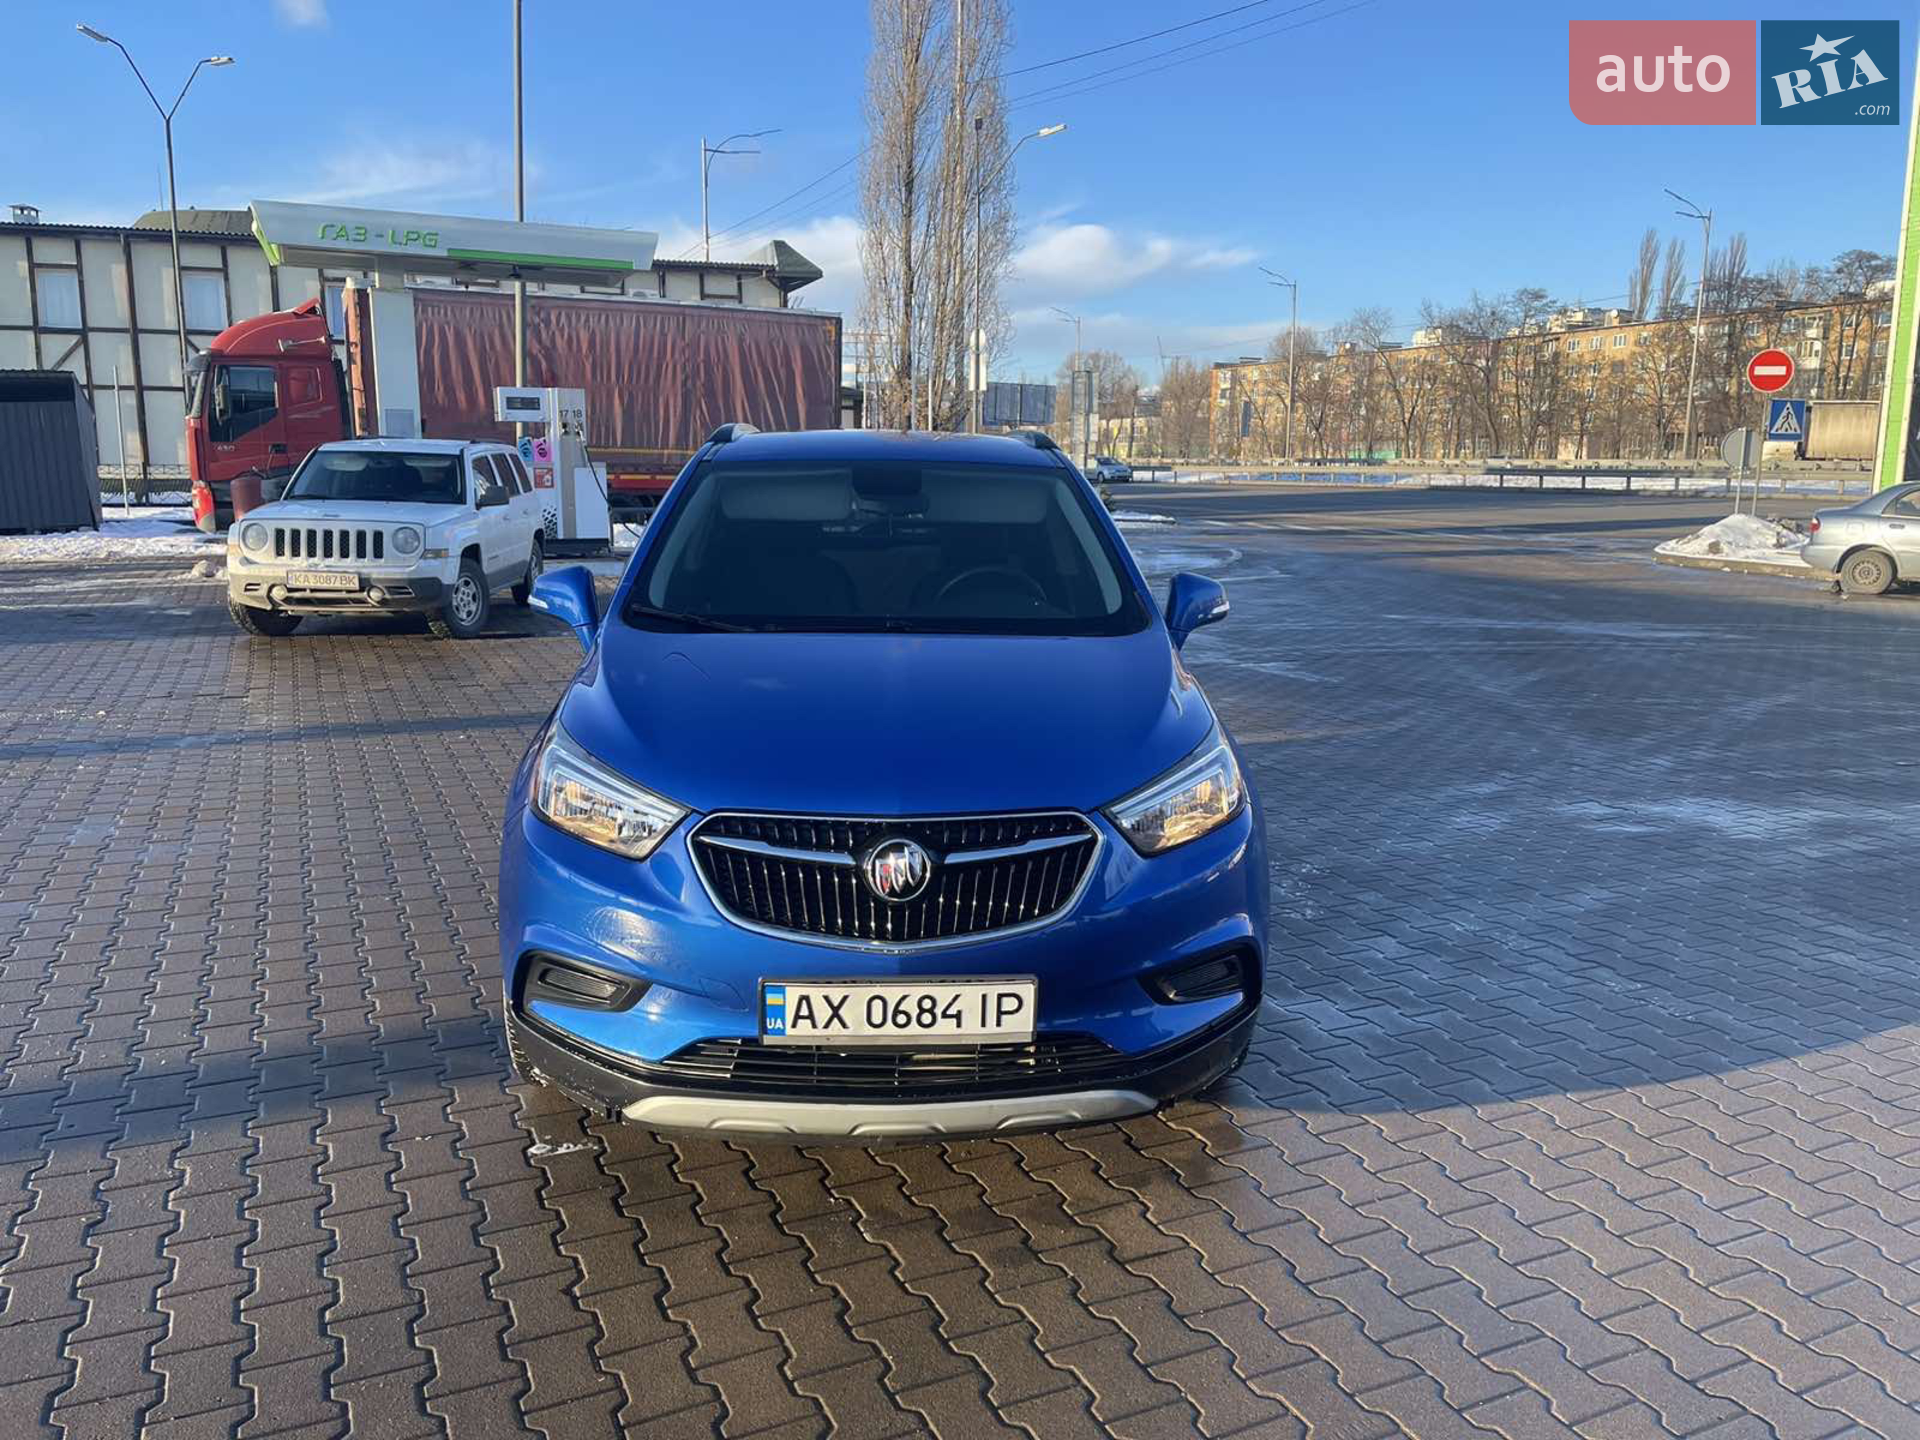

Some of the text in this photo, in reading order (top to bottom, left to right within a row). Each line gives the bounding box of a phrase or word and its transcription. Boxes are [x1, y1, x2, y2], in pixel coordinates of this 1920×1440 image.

[559, 409, 583, 419] 17 18
[294, 573, 357, 586] KA 3087 BK
[790, 992, 1025, 1029] AX 0684 IP
[766, 1018, 784, 1030] UA
